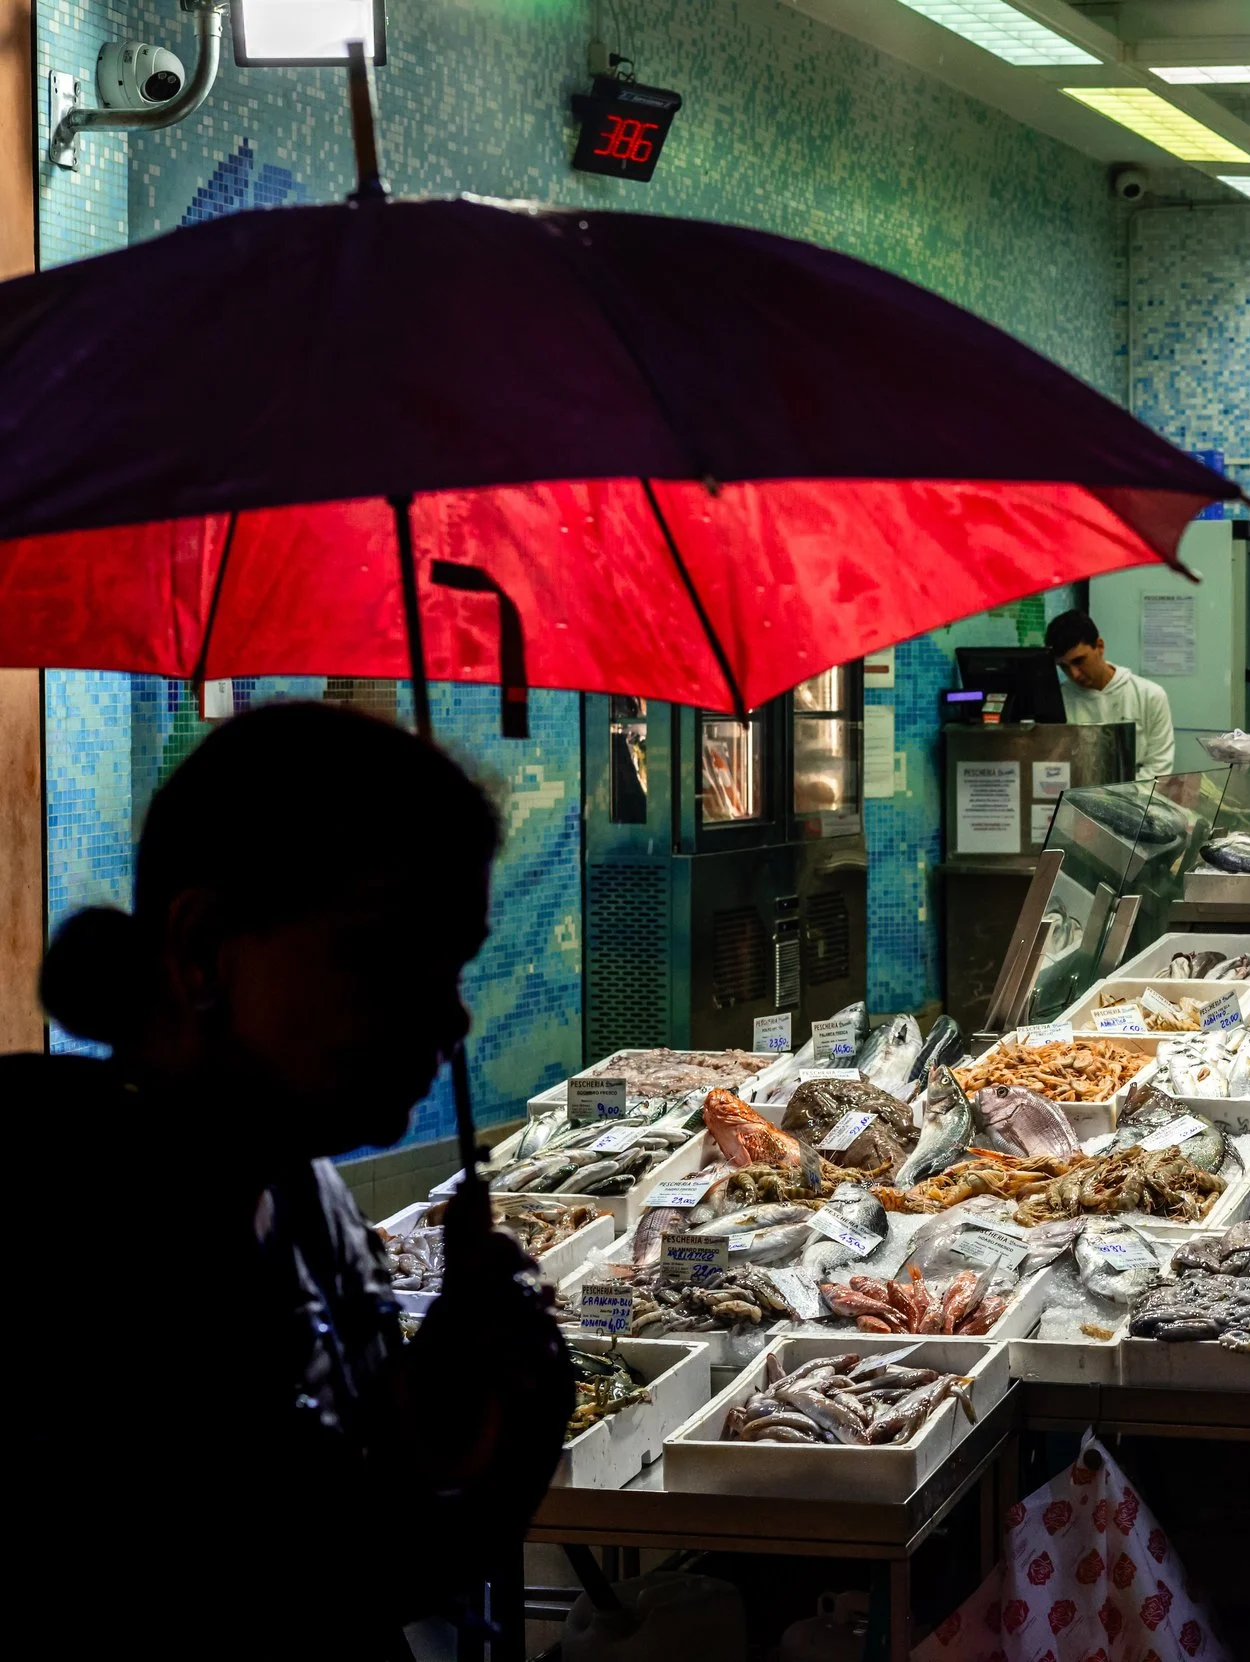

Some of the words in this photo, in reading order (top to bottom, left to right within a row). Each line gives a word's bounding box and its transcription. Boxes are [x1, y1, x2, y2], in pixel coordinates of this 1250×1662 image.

[594, 115, 660, 163] 386
[1092, 1007, 1121, 1016] PESCHERIA
[1199, 999, 1222, 1015] PESCHERIA
[813, 1020, 838, 1031] PESCHERIA
[1219, 1012, 1241, 1028] 22,00
[1017, 1022, 1050, 1033] PESCHERIA
[825, 1208, 858, 1228] PESCHERIA
[662, 1235, 702, 1244] PESCHERIA
[993, 1241, 1015, 1251] FRESCO
[582, 1285, 612, 1295] PESCHERIA
[607, 1317, 625, 1333] 4,00
